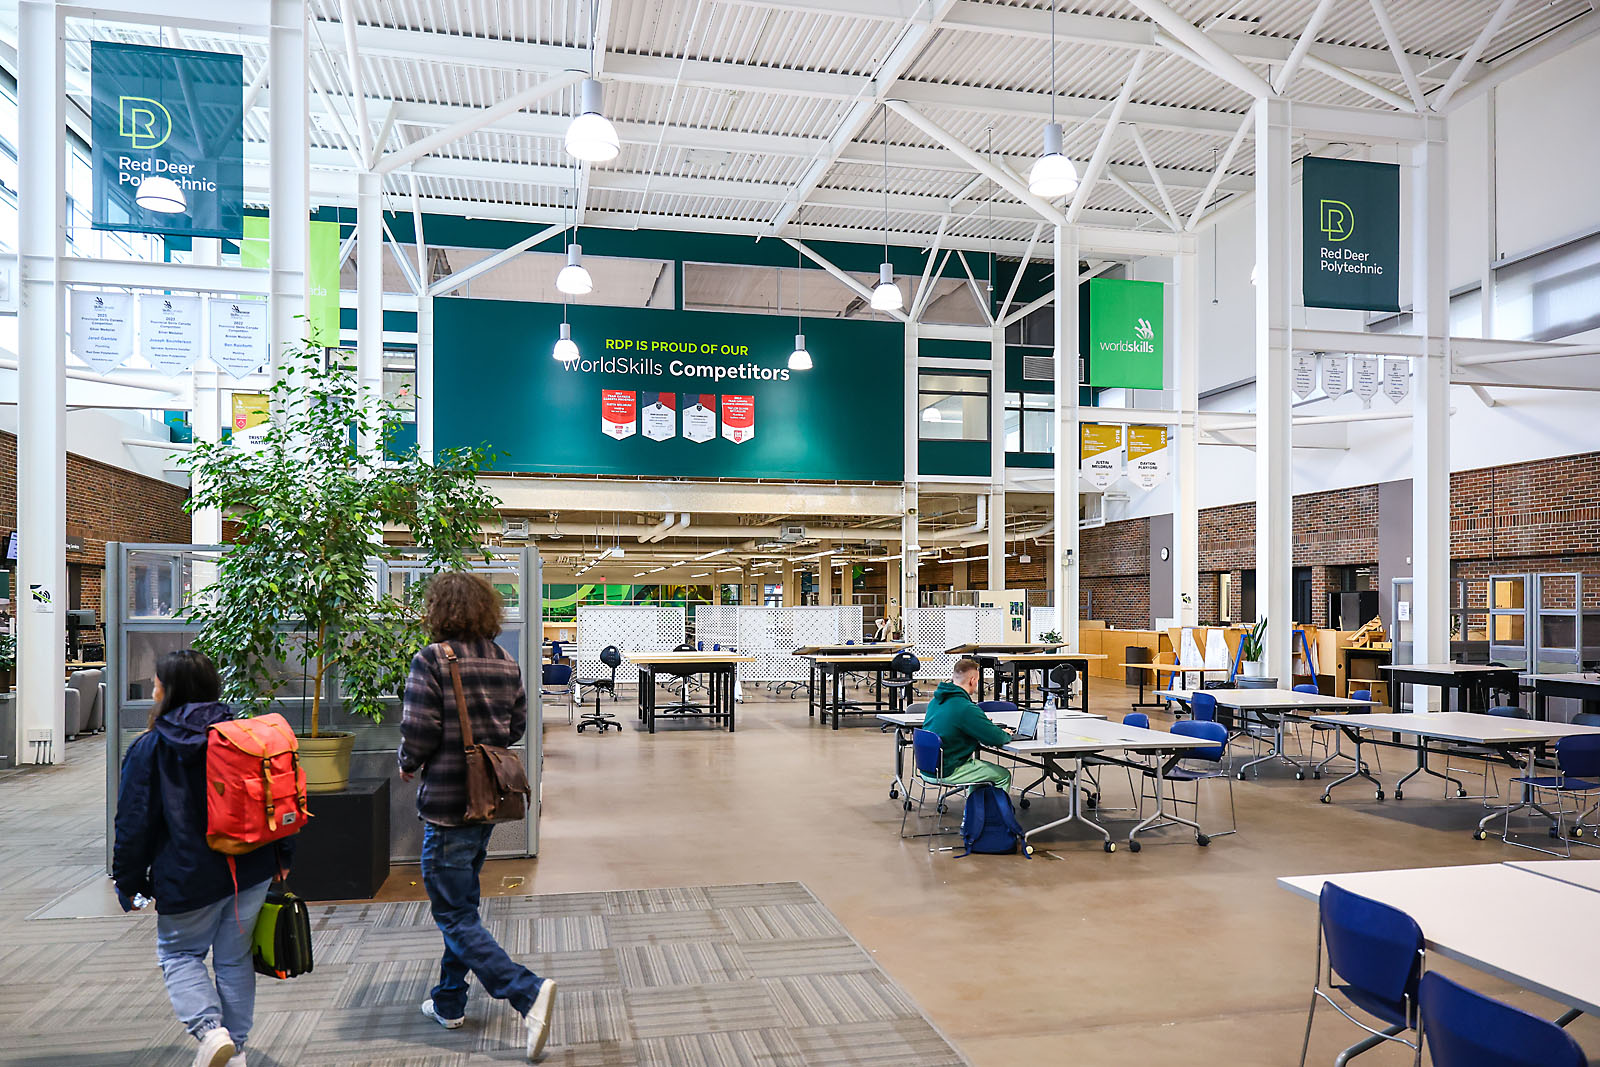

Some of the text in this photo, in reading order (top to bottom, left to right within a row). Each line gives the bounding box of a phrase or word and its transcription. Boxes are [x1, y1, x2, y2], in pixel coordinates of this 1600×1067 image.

[119, 156, 195, 174] Red Deer
[1320, 247, 1369, 261] Red Deer
[1320, 260, 1383, 275] Polytechnic
[605, 338, 749, 356] RDP IS PROUD OF OUR
[1099, 340, 1154, 353] worldskills
[562, 356, 790, 382] WorldSkills Competitors
